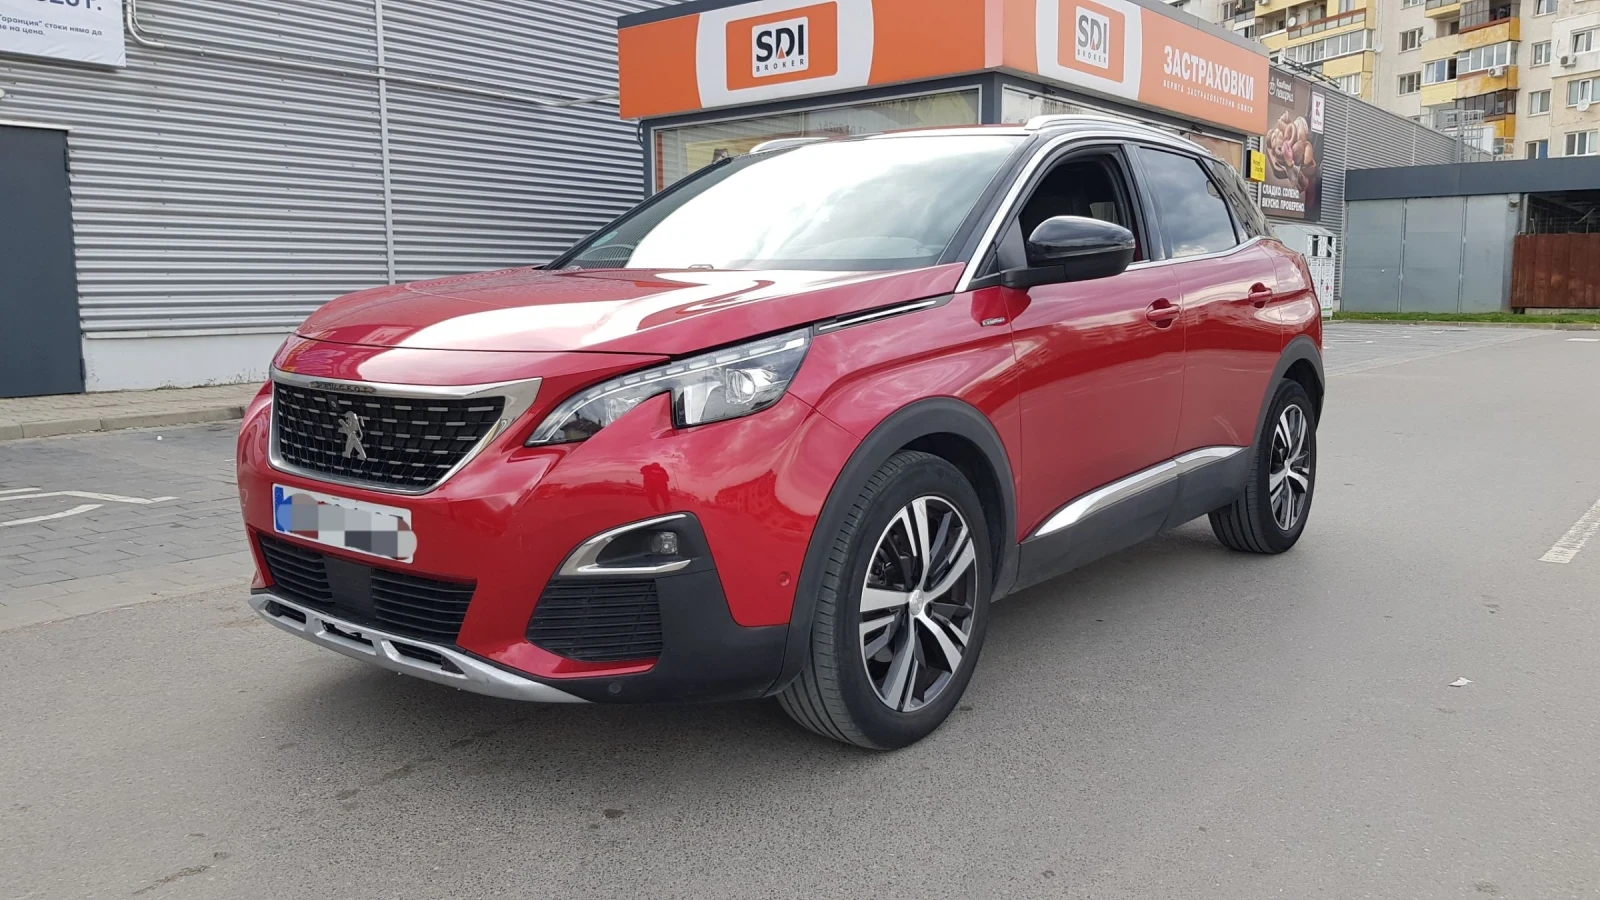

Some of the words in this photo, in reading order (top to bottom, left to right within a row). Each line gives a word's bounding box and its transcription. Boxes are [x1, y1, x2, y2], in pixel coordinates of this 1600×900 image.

[22, 27, 45, 36] цена.
[44, 22, 68, 31] стоки
[1077, 14, 1108, 54] SDI
[756, 24, 805, 63] SDI
[1077, 48, 1108, 64] BROKER
[756, 58, 805, 72] BROKER
[1163, 45, 1255, 102] ЗАСТРАХОВКИ
